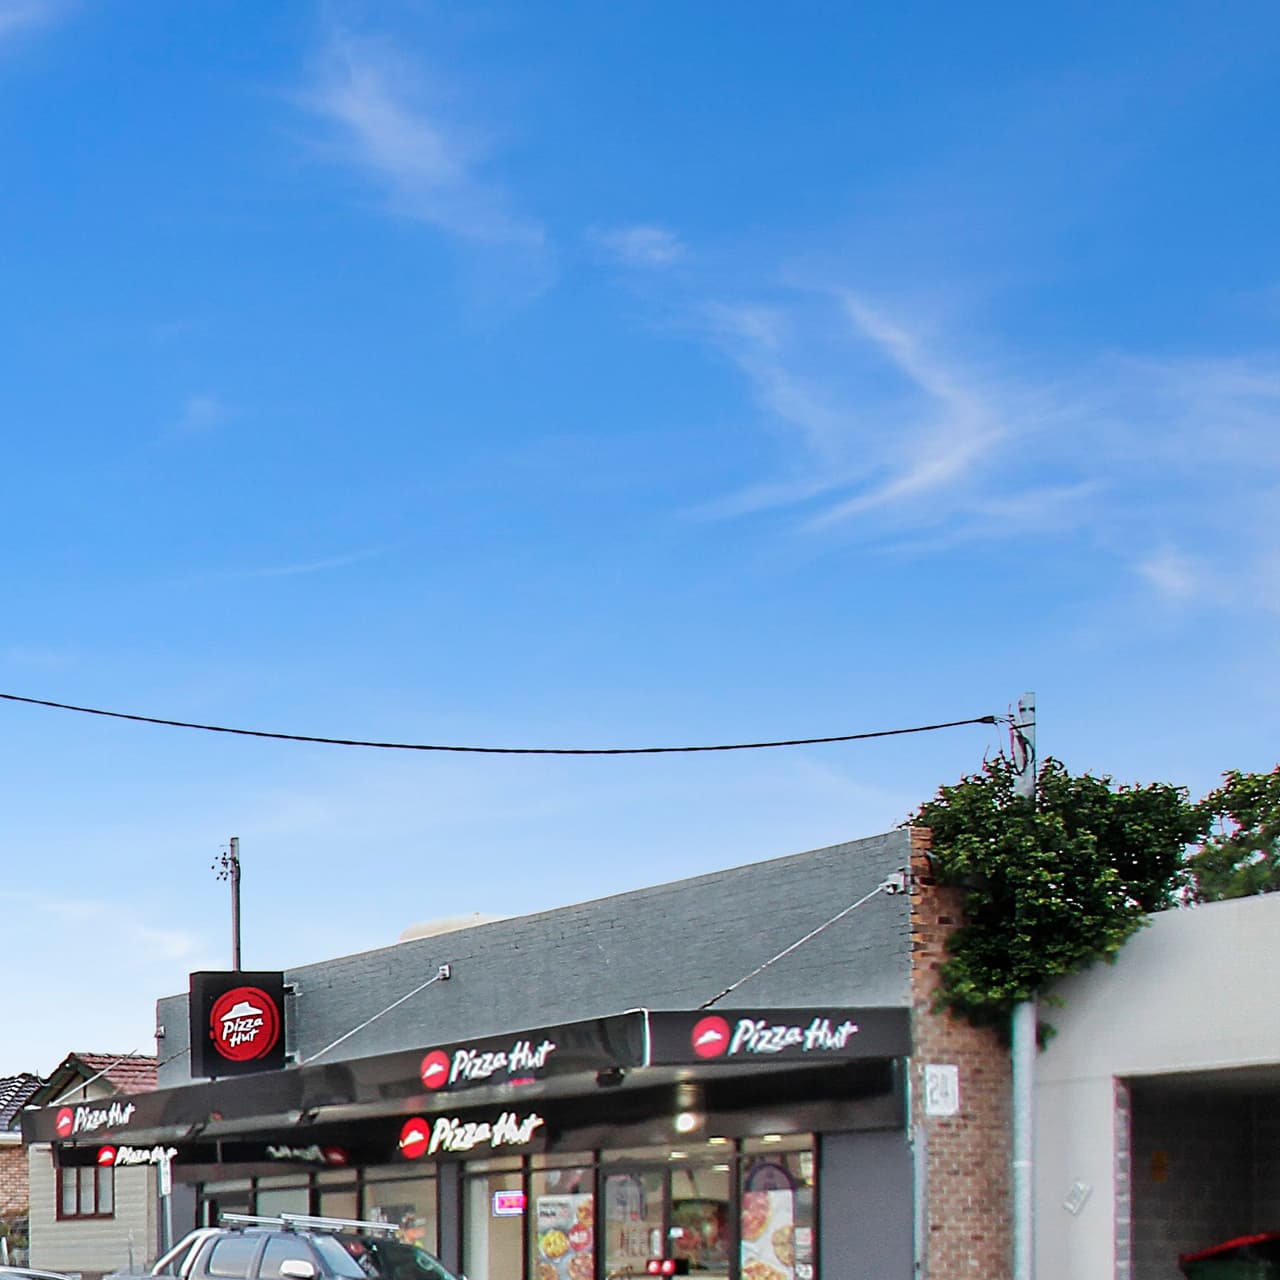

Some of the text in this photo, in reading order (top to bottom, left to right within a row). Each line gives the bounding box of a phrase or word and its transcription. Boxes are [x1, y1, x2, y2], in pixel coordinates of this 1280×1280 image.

[222, 1017, 264, 1041] Pizza
[229, 1029, 259, 1048] Hut
[727, 1016, 859, 1057] Pizza Hut
[448, 1040, 556, 1085] Pizza Hut
[72, 1102, 136, 1134] Pizza Hut
[428, 1112, 545, 1156] Pizza Hut
[115, 1147, 150, 1166] Pizza
